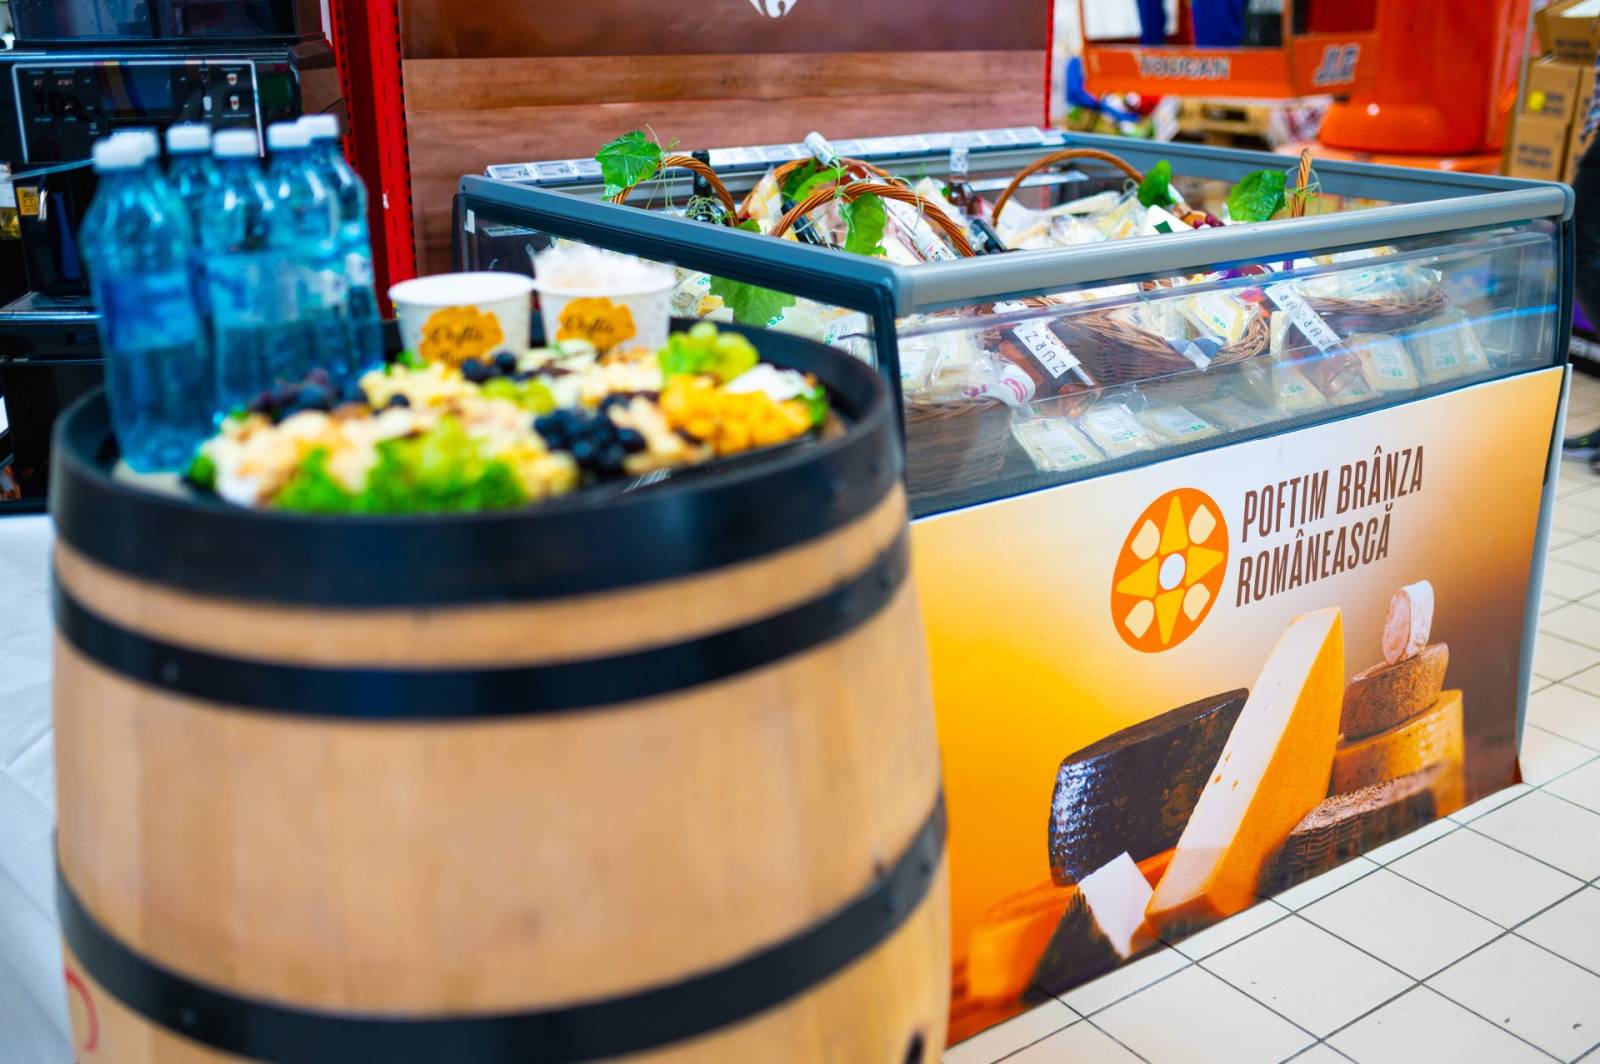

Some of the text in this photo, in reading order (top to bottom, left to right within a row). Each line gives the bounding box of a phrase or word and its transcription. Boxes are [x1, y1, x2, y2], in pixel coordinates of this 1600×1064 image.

[1241, 446, 1423, 543] POFTIM BRÂNZA
[1236, 502, 1393, 608] ROMÂNEASCĂ
